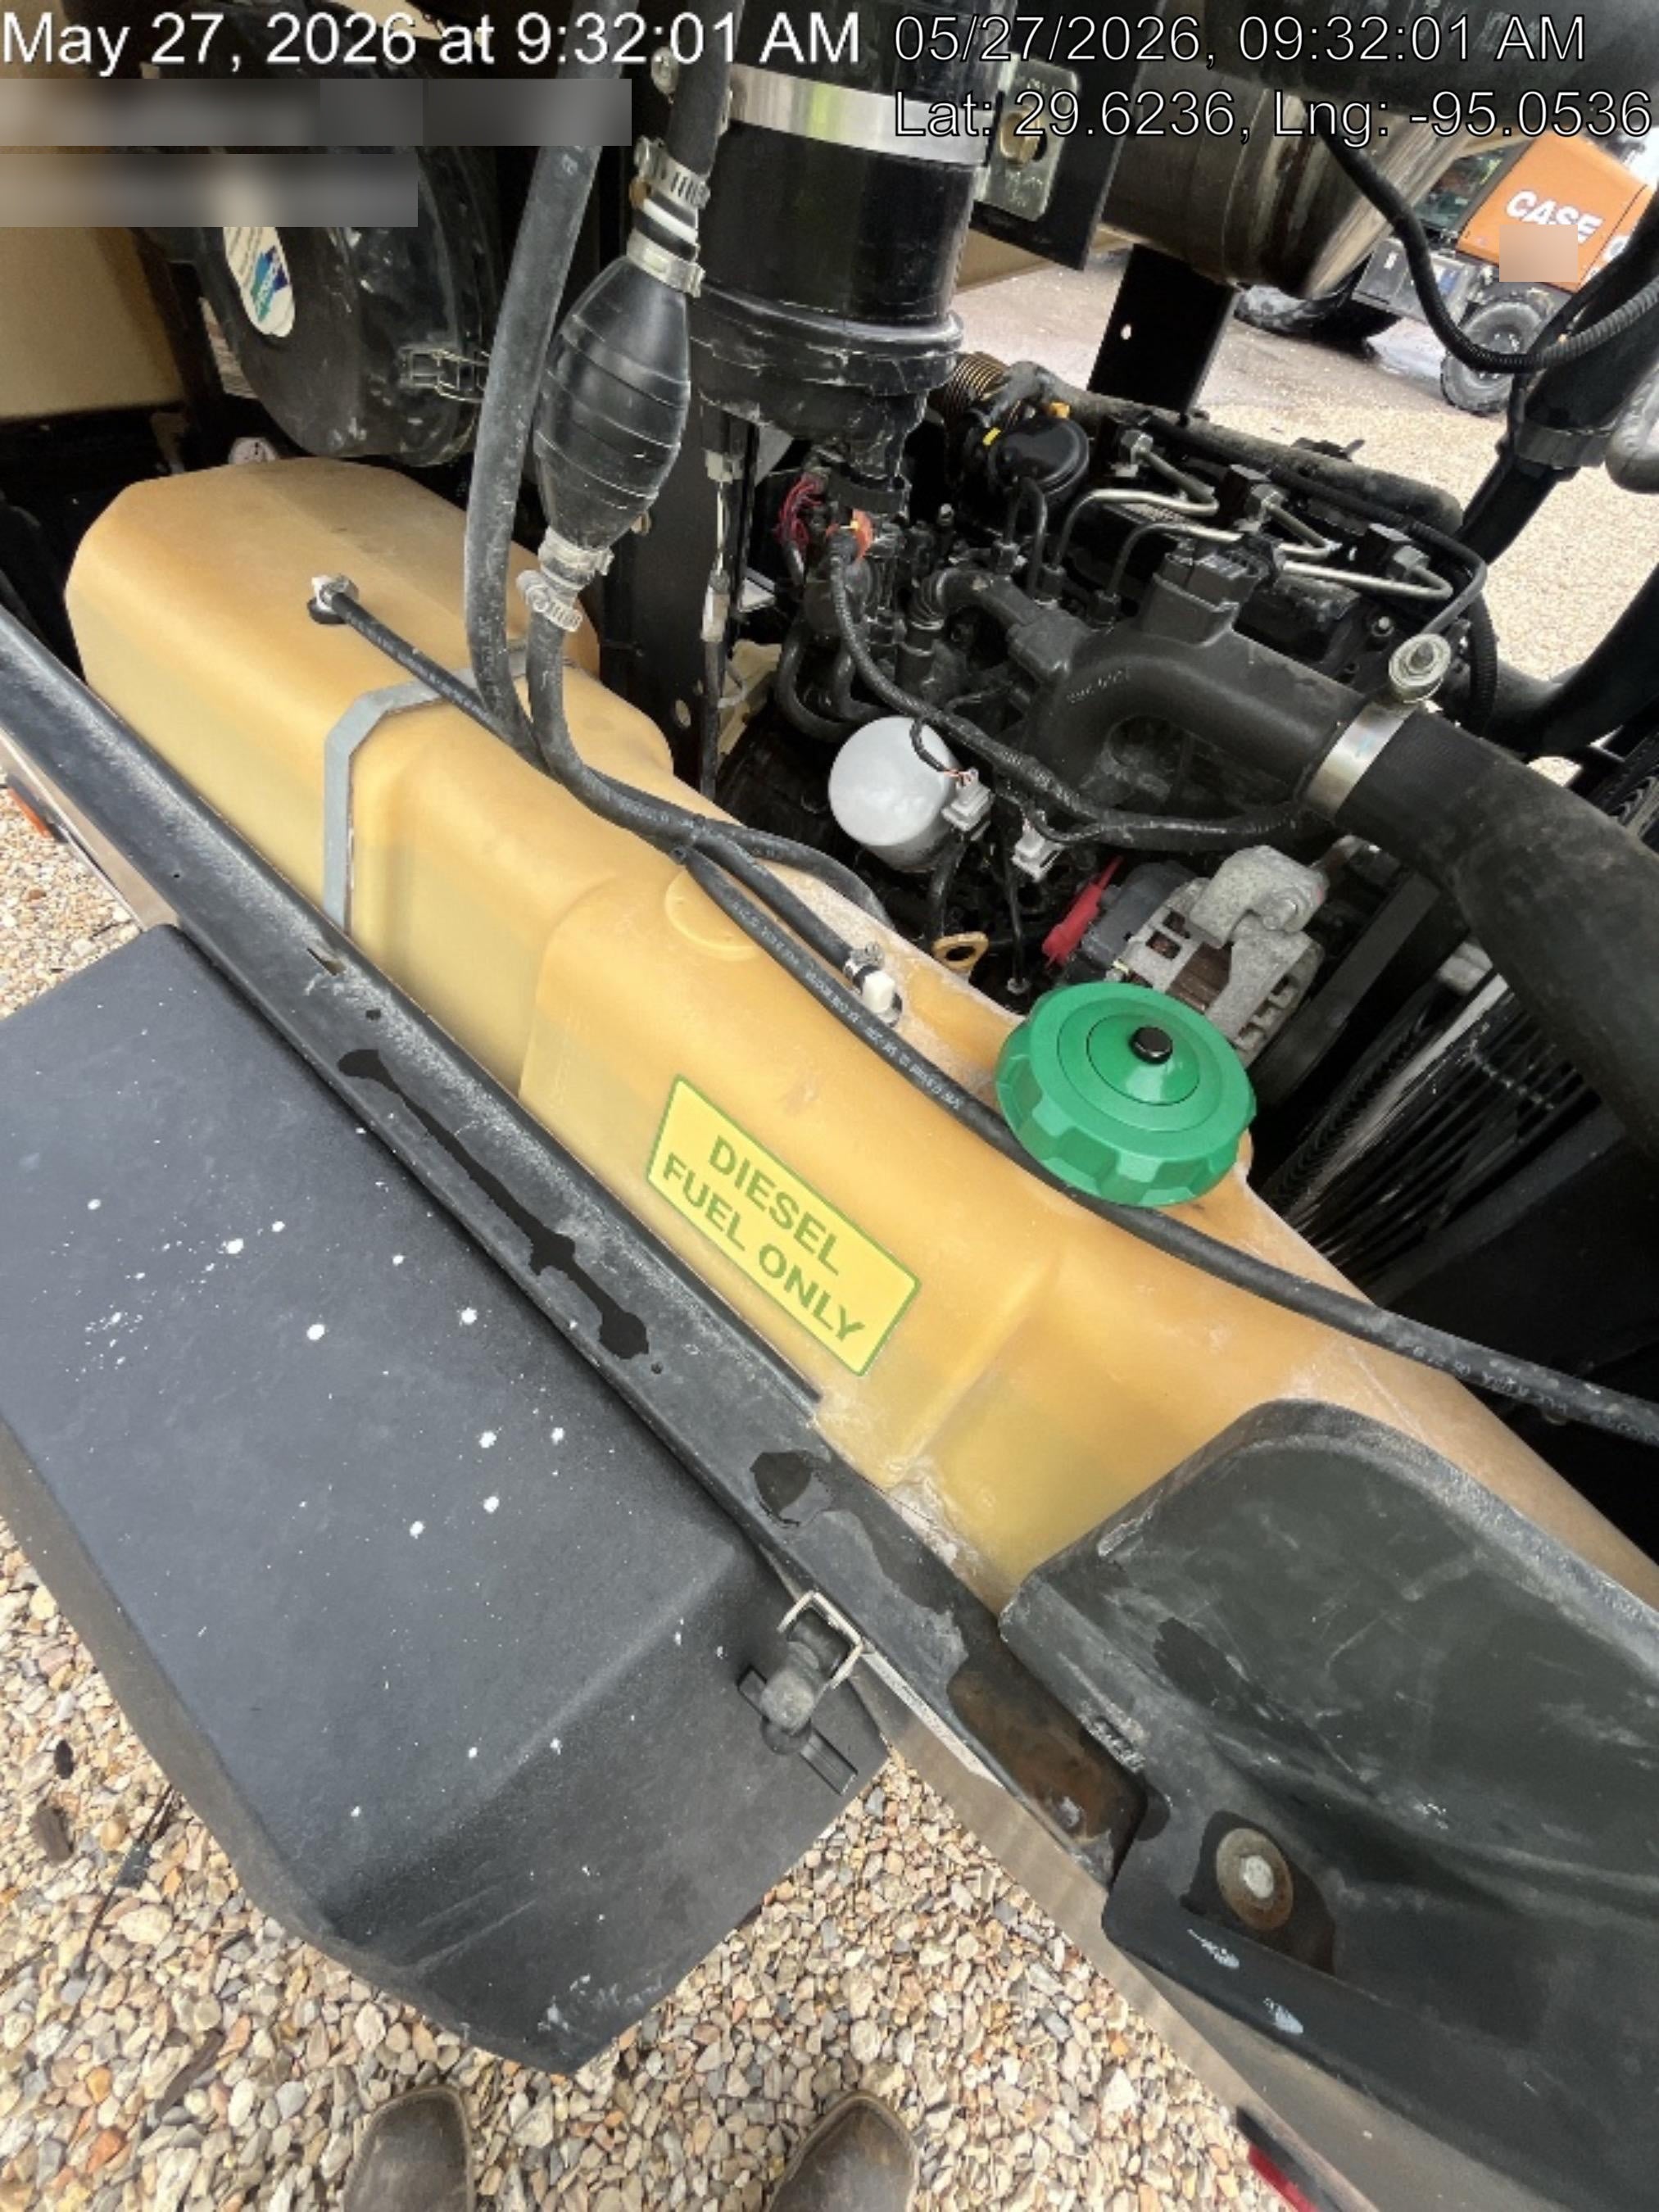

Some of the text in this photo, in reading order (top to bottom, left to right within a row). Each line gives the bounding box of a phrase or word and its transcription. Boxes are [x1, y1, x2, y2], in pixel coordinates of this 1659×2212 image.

[1506, 190, 1604, 243] CASE
[663, 1153, 865, 1341] FUEL ONLY
[708, 1135, 840, 1276] DIESEL
